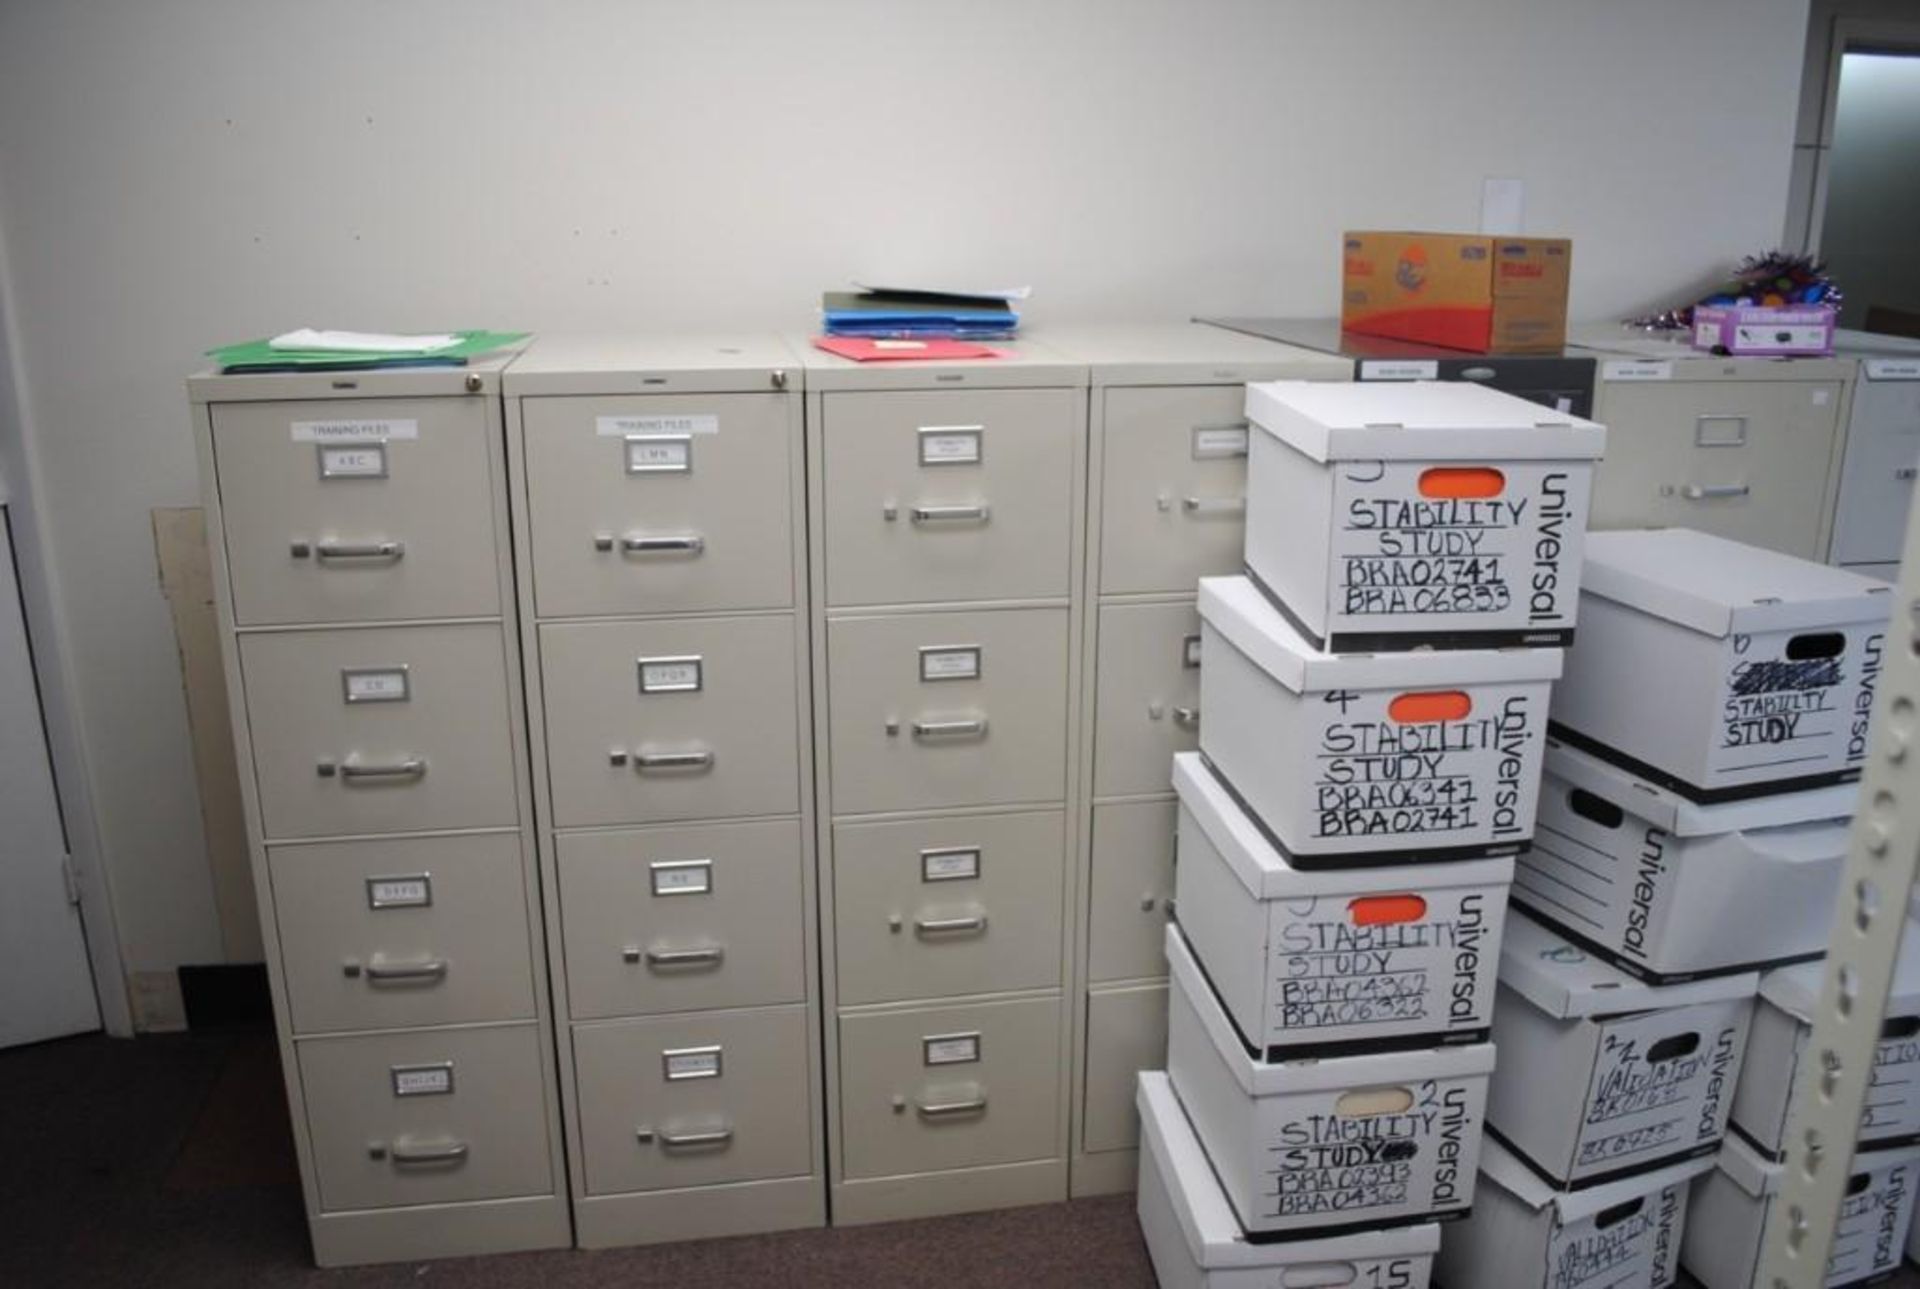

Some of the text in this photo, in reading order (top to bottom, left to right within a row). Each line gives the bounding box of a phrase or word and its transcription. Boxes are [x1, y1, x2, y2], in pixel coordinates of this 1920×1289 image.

[312, 425, 360, 436] TRAINING
[1349, 498, 1528, 530] STABILITY
[1379, 529, 1484, 557] STUDY
[1529, 473, 1572, 621] universal
[1346, 558, 1504, 587] BRA02741
[1845, 634, 1884, 762] universal
[1322, 715, 1505, 754] STABILITY
[1726, 713, 1801, 747] STUDY
[1324, 753, 1445, 784] STUDY
[1492, 696, 1533, 836] universal
[1319, 806, 1478, 837] BRA02741
[1622, 827, 1667, 959] universal
[1279, 922, 1459, 952] STABILITY
[1288, 951, 1392, 977] STUDY
[1449, 894, 1488, 1023] universal
[1419, 1079, 1440, 1108] 2
[1697, 1028, 1735, 1140] universal
[1281, 1111, 1437, 1145] STABILITY
[1281, 1139, 1386, 1171] STUDY
[1431, 1088, 1470, 1209] universal
[1873, 1166, 1908, 1270] universal
